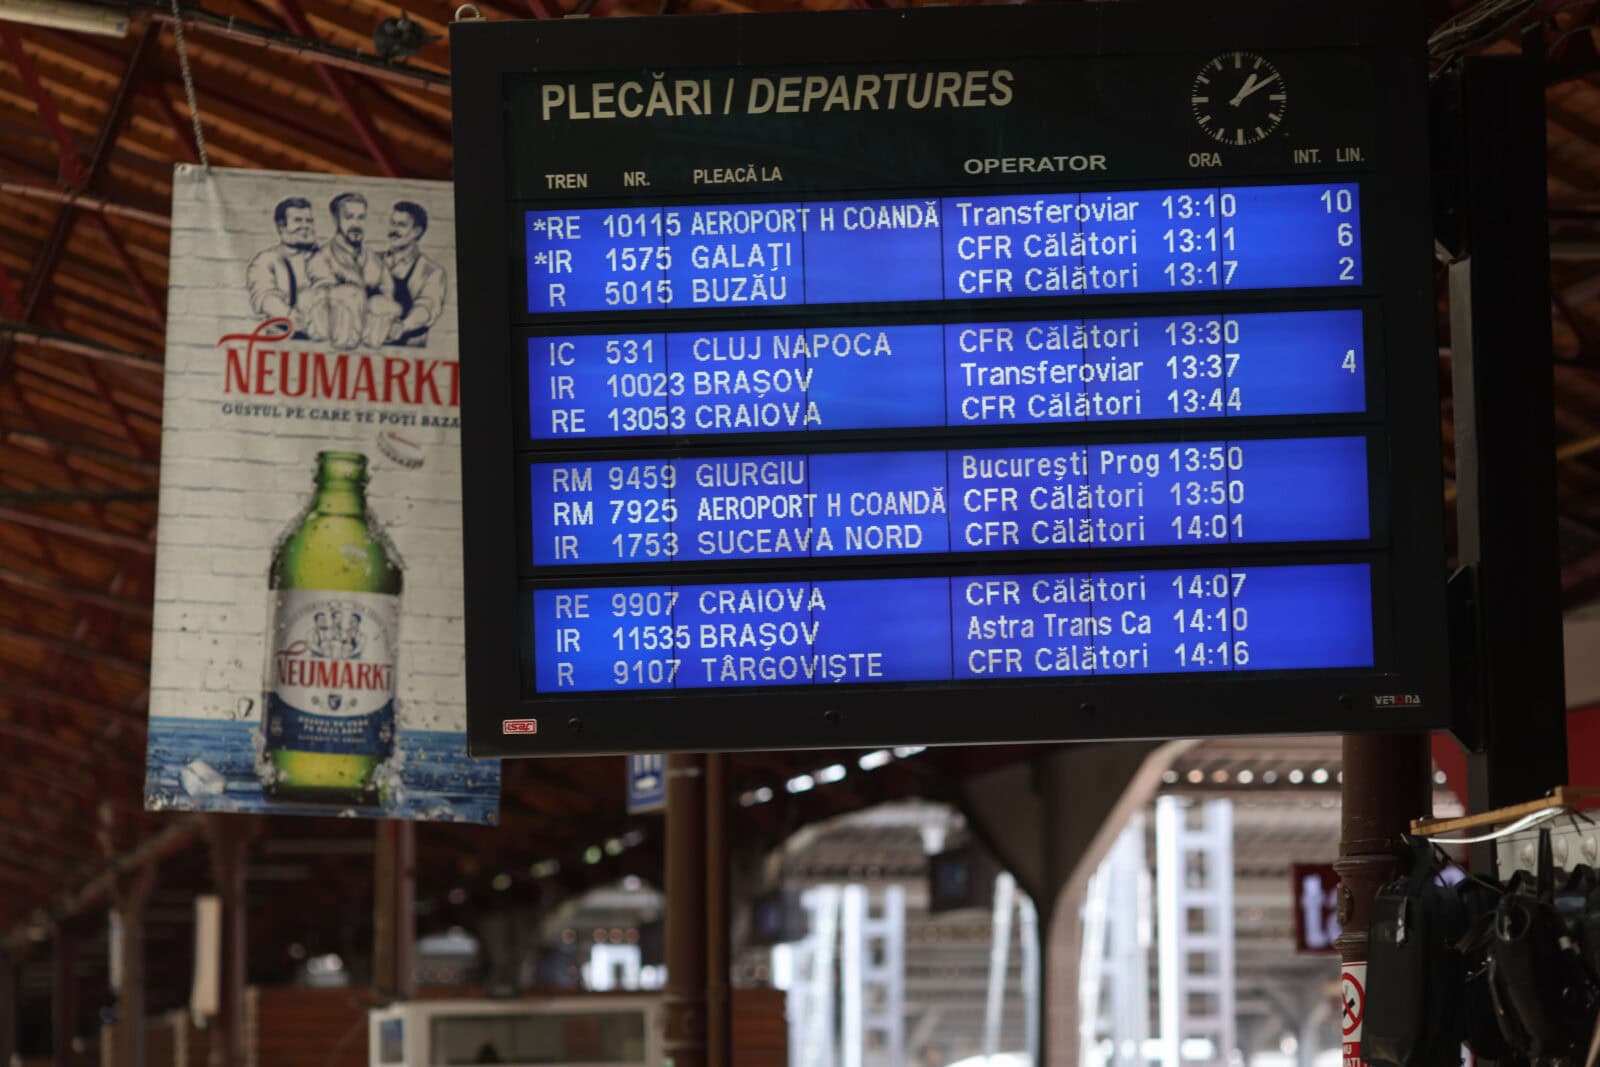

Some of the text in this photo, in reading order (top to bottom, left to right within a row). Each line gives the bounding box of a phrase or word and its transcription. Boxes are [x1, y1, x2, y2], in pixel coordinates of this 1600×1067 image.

[541, 69, 1015, 121] PLECĂRI / DEPARTURES
[544, 147, 1365, 189] TREN NR. PLEACĂ LA OPERATOR ORA INT. LIN.
[603, 212, 680, 237] 10115
[690, 208, 810, 235] AEROPORT
[820, 207, 834, 231] H
[843, 200, 939, 230] COANDĂ
[956, 196, 1139, 226] Transferoviar
[1161, 193, 1236, 219] 13:10
[1320, 189, 1351, 213] 10
[605, 245, 671, 271] 1575
[957, 234, 1011, 260] CFR
[1023, 228, 1136, 258] Călători
[1162, 226, 1234, 253] 13:11
[1337, 222, 1352, 246] 6
[549, 256, 1353, 306] R 5015 BUZĂU CFR Călători 13:17 2
[217, 317, 460, 406] NEUMARKT
[550, 319, 1238, 366] IC 531 CLUJ NAPOCA CFR Călători 13:30
[550, 375, 574, 399] IR
[606, 371, 684, 397] 10023
[959, 355, 1143, 386] Transferoviar
[1166, 353, 1240, 379] 13:37
[1341, 349, 1355, 372] 4
[222, 403, 281, 417] GUSTUL
[286, 406, 305, 418] PE
[309, 407, 350, 421] CARE
[356, 411, 373, 423] TE
[551, 386, 1241, 433] RE 13053 CRAIOVA CFR Călători 13:44
[553, 467, 592, 492] RM
[608, 465, 676, 490] 9459
[695, 460, 803, 487] GIURGIU
[1100, 450, 1159, 477] Prog
[1168, 446, 1242, 472] 13:50
[553, 479, 1244, 525] RM 7925 AEROPORT H COANDĂ CFR Călători 13:50
[554, 513, 1242, 559] IR 1753 SUCEAVA NORD CFR Călători 14:01
[556, 573, 1246, 618] RE 9907 CRAIOVA CFR Călători 14:07
[556, 628, 580, 652] IR
[612, 624, 690, 650] 11535
[967, 614, 1034, 639] Astra
[1043, 613, 1112, 637] Trans
[1121, 610, 1151, 634] Ca
[1173, 607, 1247, 633] 14:10
[276, 640, 393, 690] NEUMARKT
[557, 662, 573, 685] R
[613, 658, 681, 684] 9107
[968, 648, 1022, 673] CFR
[1034, 642, 1147, 671] Călători
[1174, 640, 1248, 666] 14:16
